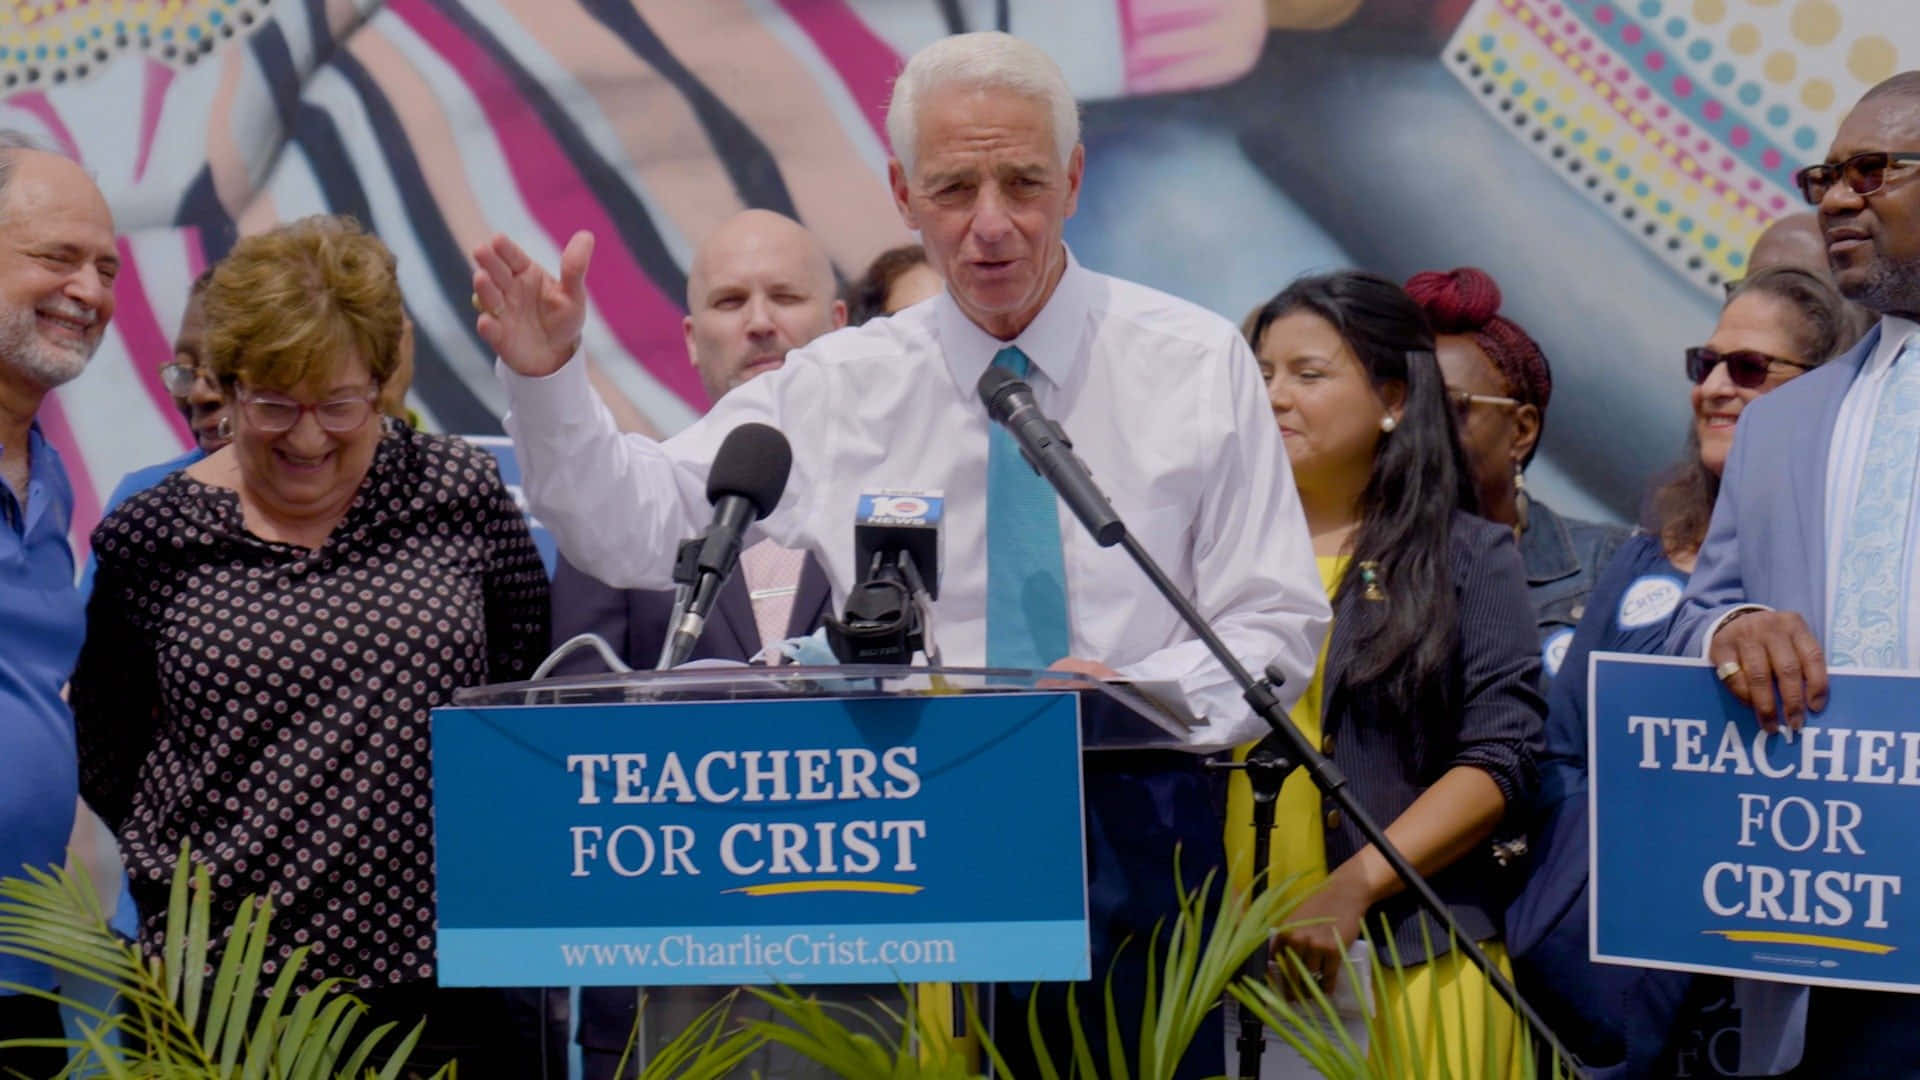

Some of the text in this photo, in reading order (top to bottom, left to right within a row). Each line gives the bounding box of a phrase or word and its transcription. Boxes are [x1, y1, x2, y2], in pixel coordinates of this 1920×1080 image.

[866, 515, 927, 525] NEWS
[871, 496, 929, 518] 10
[567, 746, 921, 805] TEACHERS
[570, 820, 926, 877] FOR CRIST
[1737, 793, 1866, 856] FOR
[1702, 861, 1901, 929] CRIST
[560, 933, 957, 968] www.CharlieCrist.com
